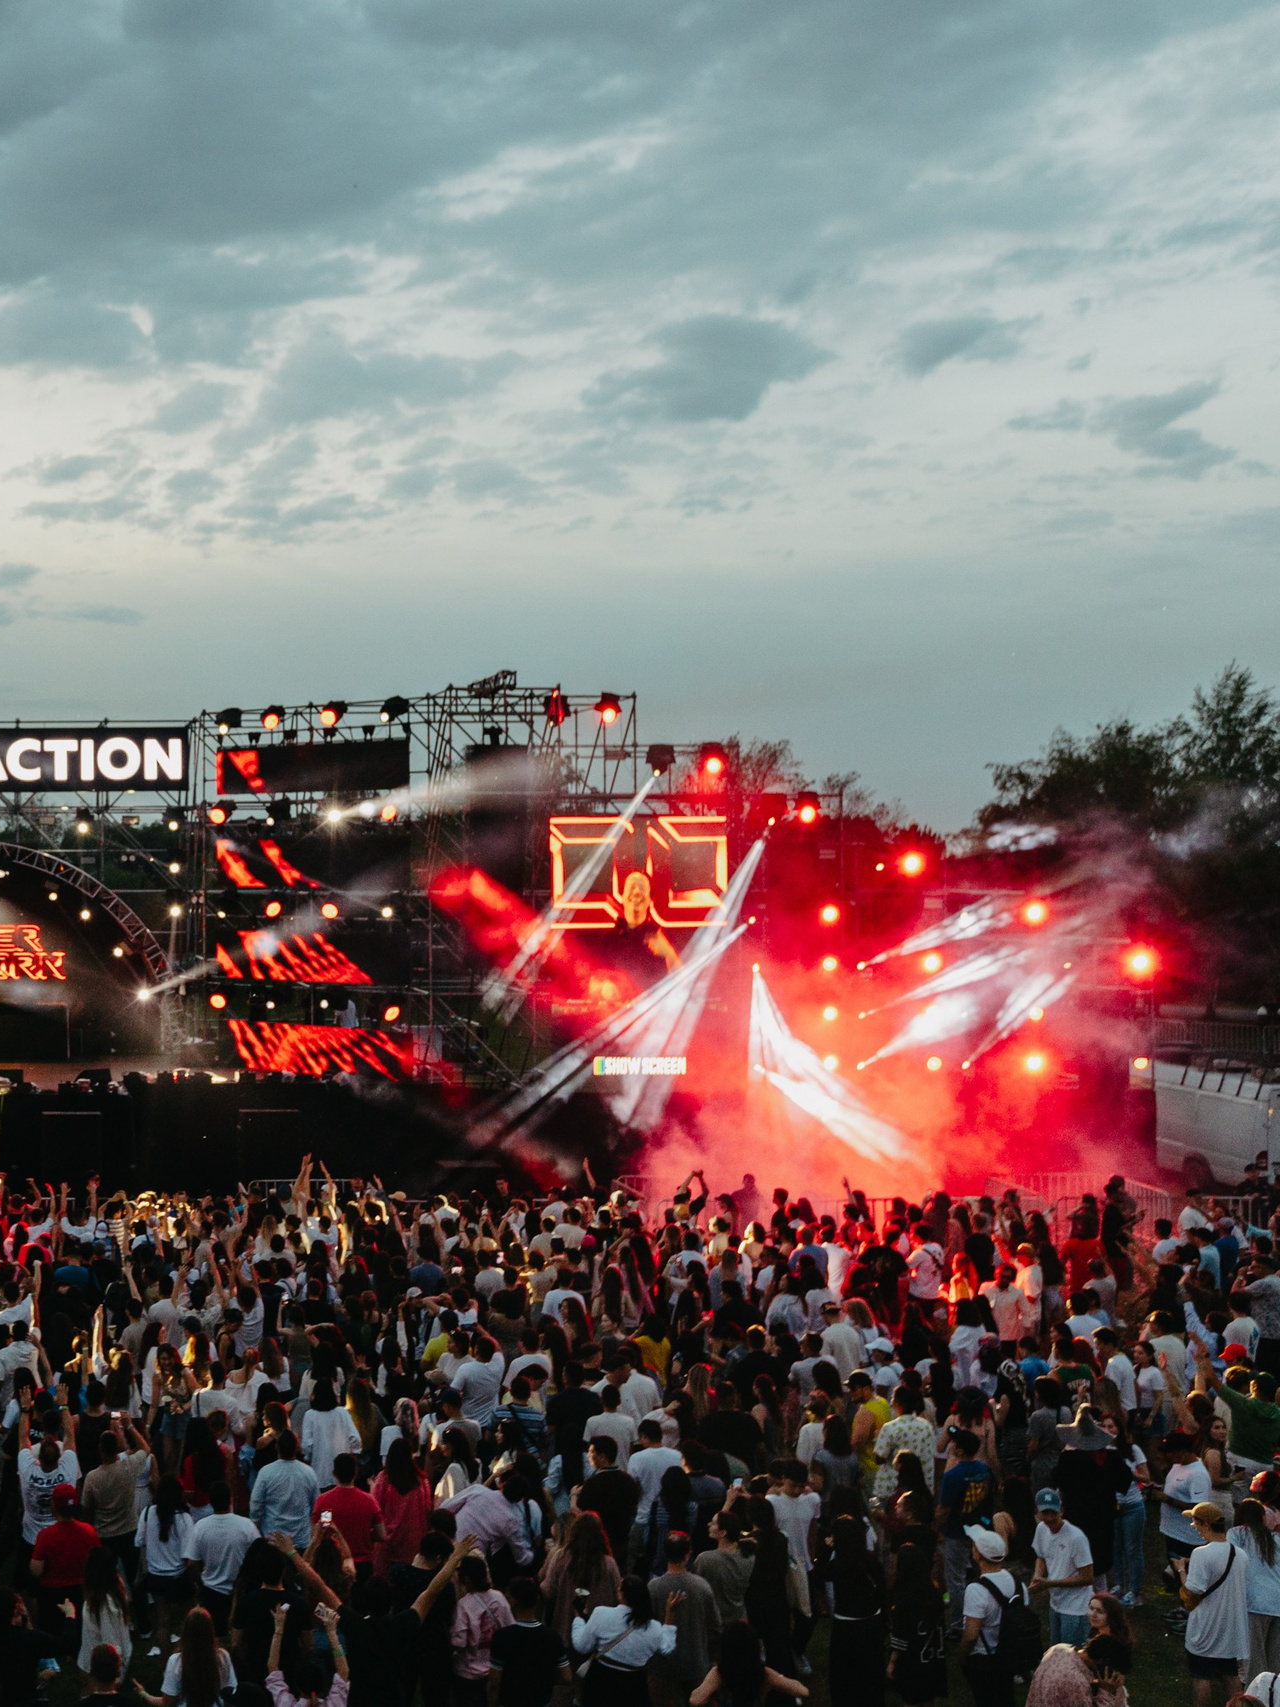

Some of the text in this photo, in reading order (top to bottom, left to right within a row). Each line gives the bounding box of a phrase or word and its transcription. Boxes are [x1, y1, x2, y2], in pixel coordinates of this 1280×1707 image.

[604, 1056, 687, 1075] SHOW SCREEN
[29, 1474, 45, 1485] NO
